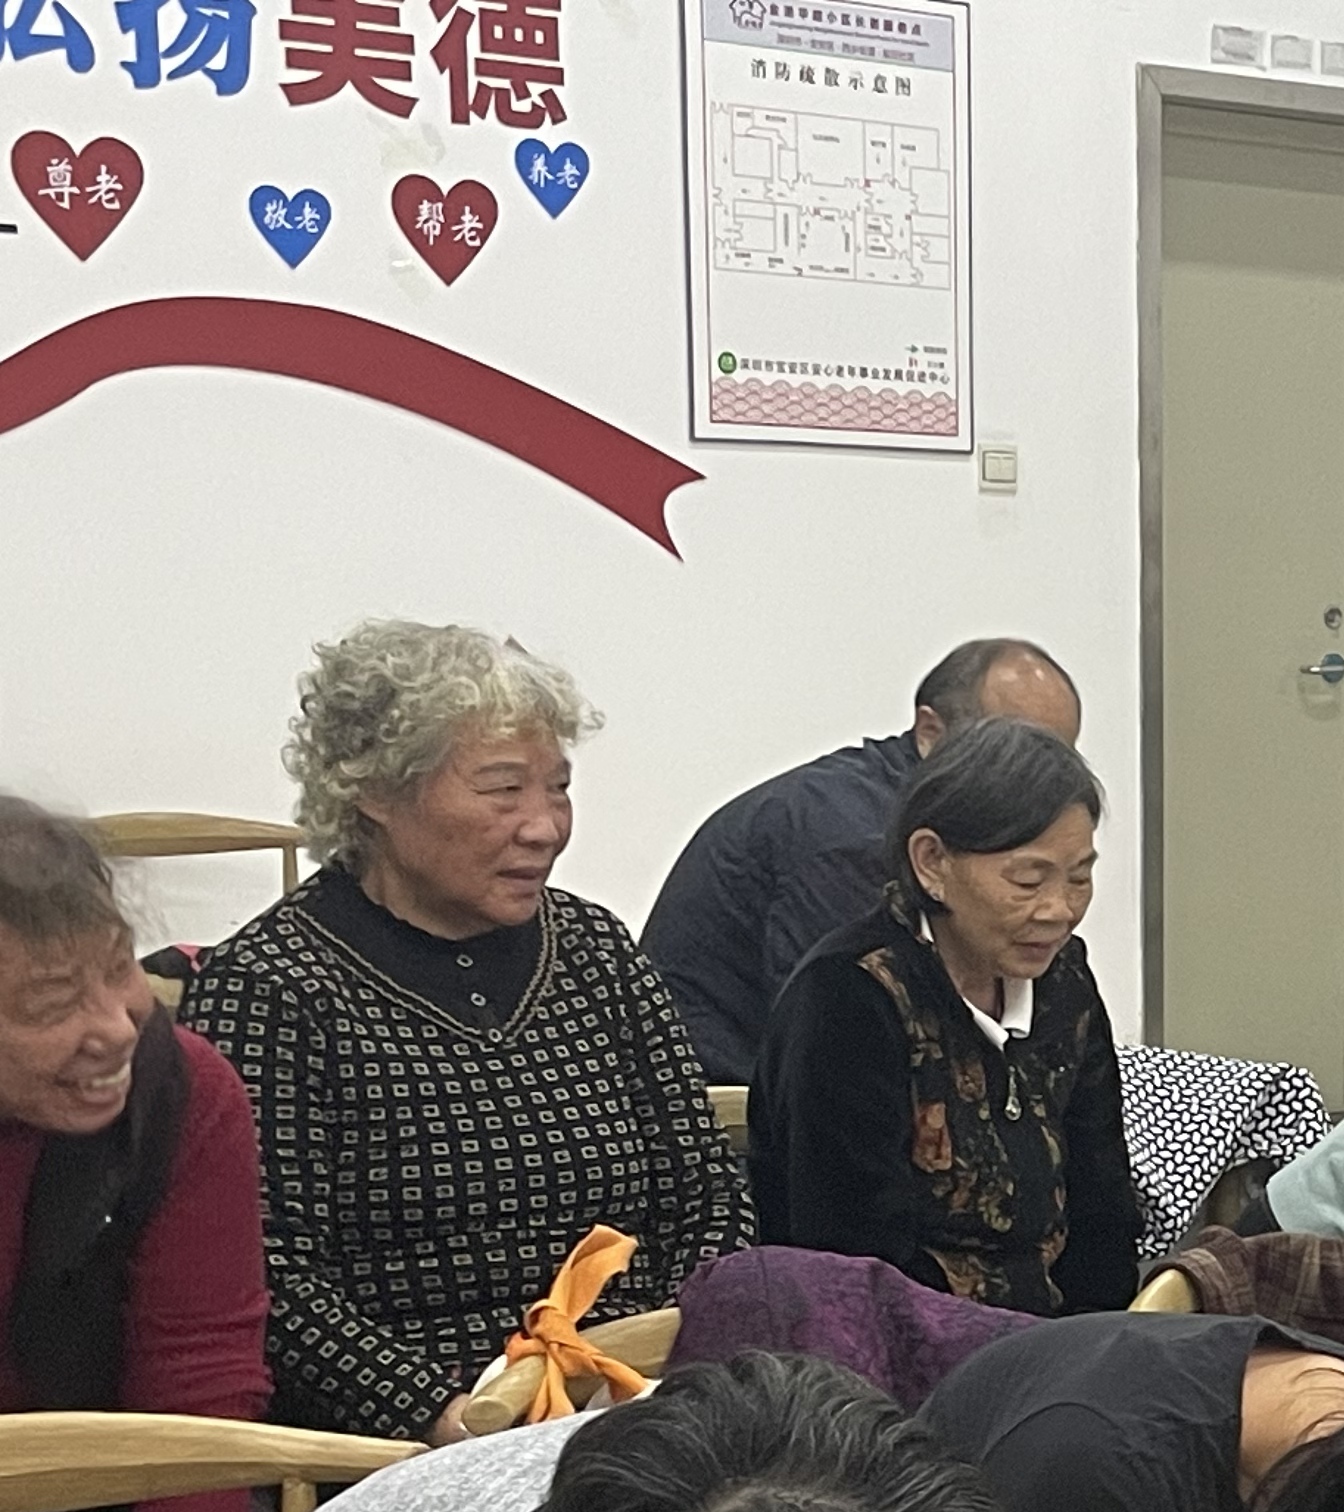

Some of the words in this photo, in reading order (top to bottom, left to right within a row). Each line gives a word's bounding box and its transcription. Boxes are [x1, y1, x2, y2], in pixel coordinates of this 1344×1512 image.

[751, 58, 911, 96] 消防疏散示意图
[38, 157, 124, 210] 尊老
[528, 153, 580, 189] 养老
[263, 199, 320, 233] 敬老
[415, 199, 484, 247] 帮老
